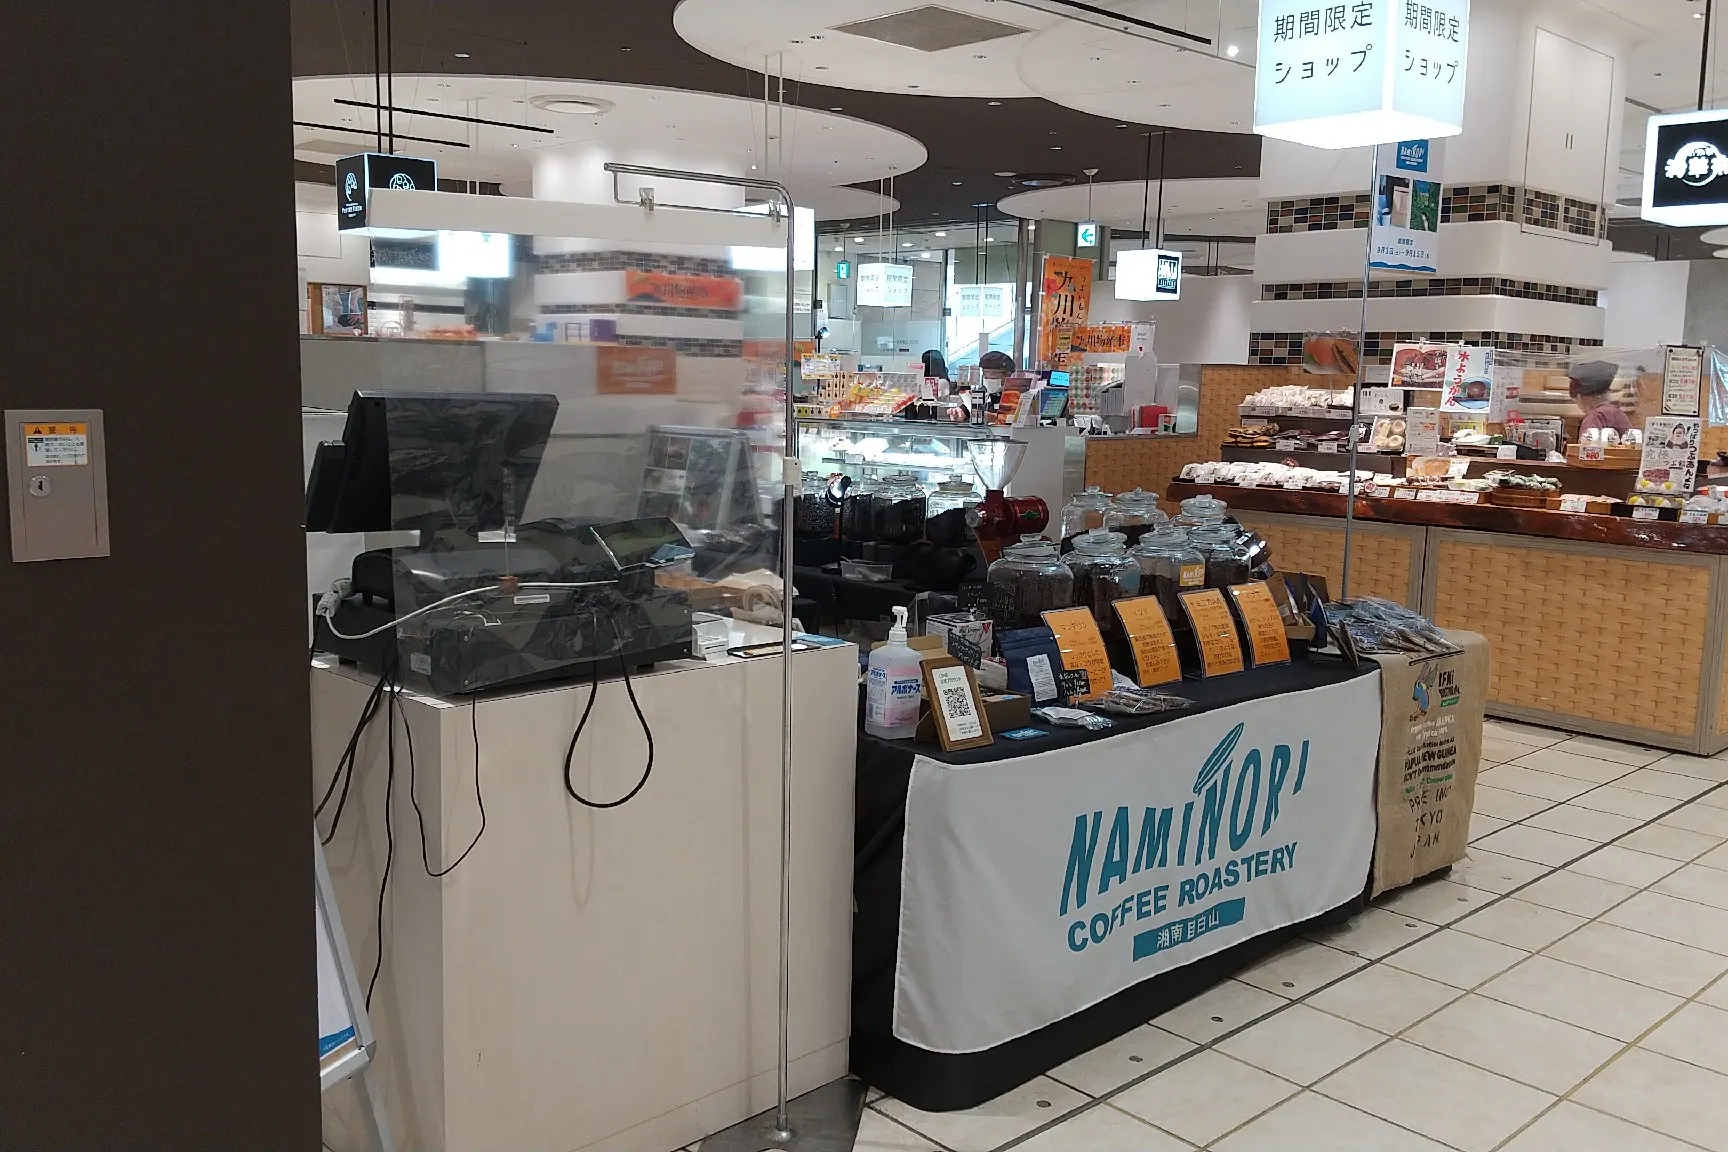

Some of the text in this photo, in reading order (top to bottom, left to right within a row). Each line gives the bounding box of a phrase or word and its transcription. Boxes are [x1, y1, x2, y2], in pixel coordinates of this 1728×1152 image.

[1273, 1, 1373, 43] 期間限定
[1404, 0, 1460, 43] 期間限定
[1275, 43, 1373, 85] ショップ
[1404, 49, 1459, 84] ショップ
[1444, 350, 1471, 407] 水ようかん
[1059, 621, 1088, 631] マンデリン
[890, 683, 921, 695] アルボナース
[1059, 739, 1310, 918] NAMINORI
[1415, 809, 1443, 832] TKYO
[1067, 841, 1298, 952] COFFEE ROASTERY
[1156, 924, 1183, 949] 湘南
